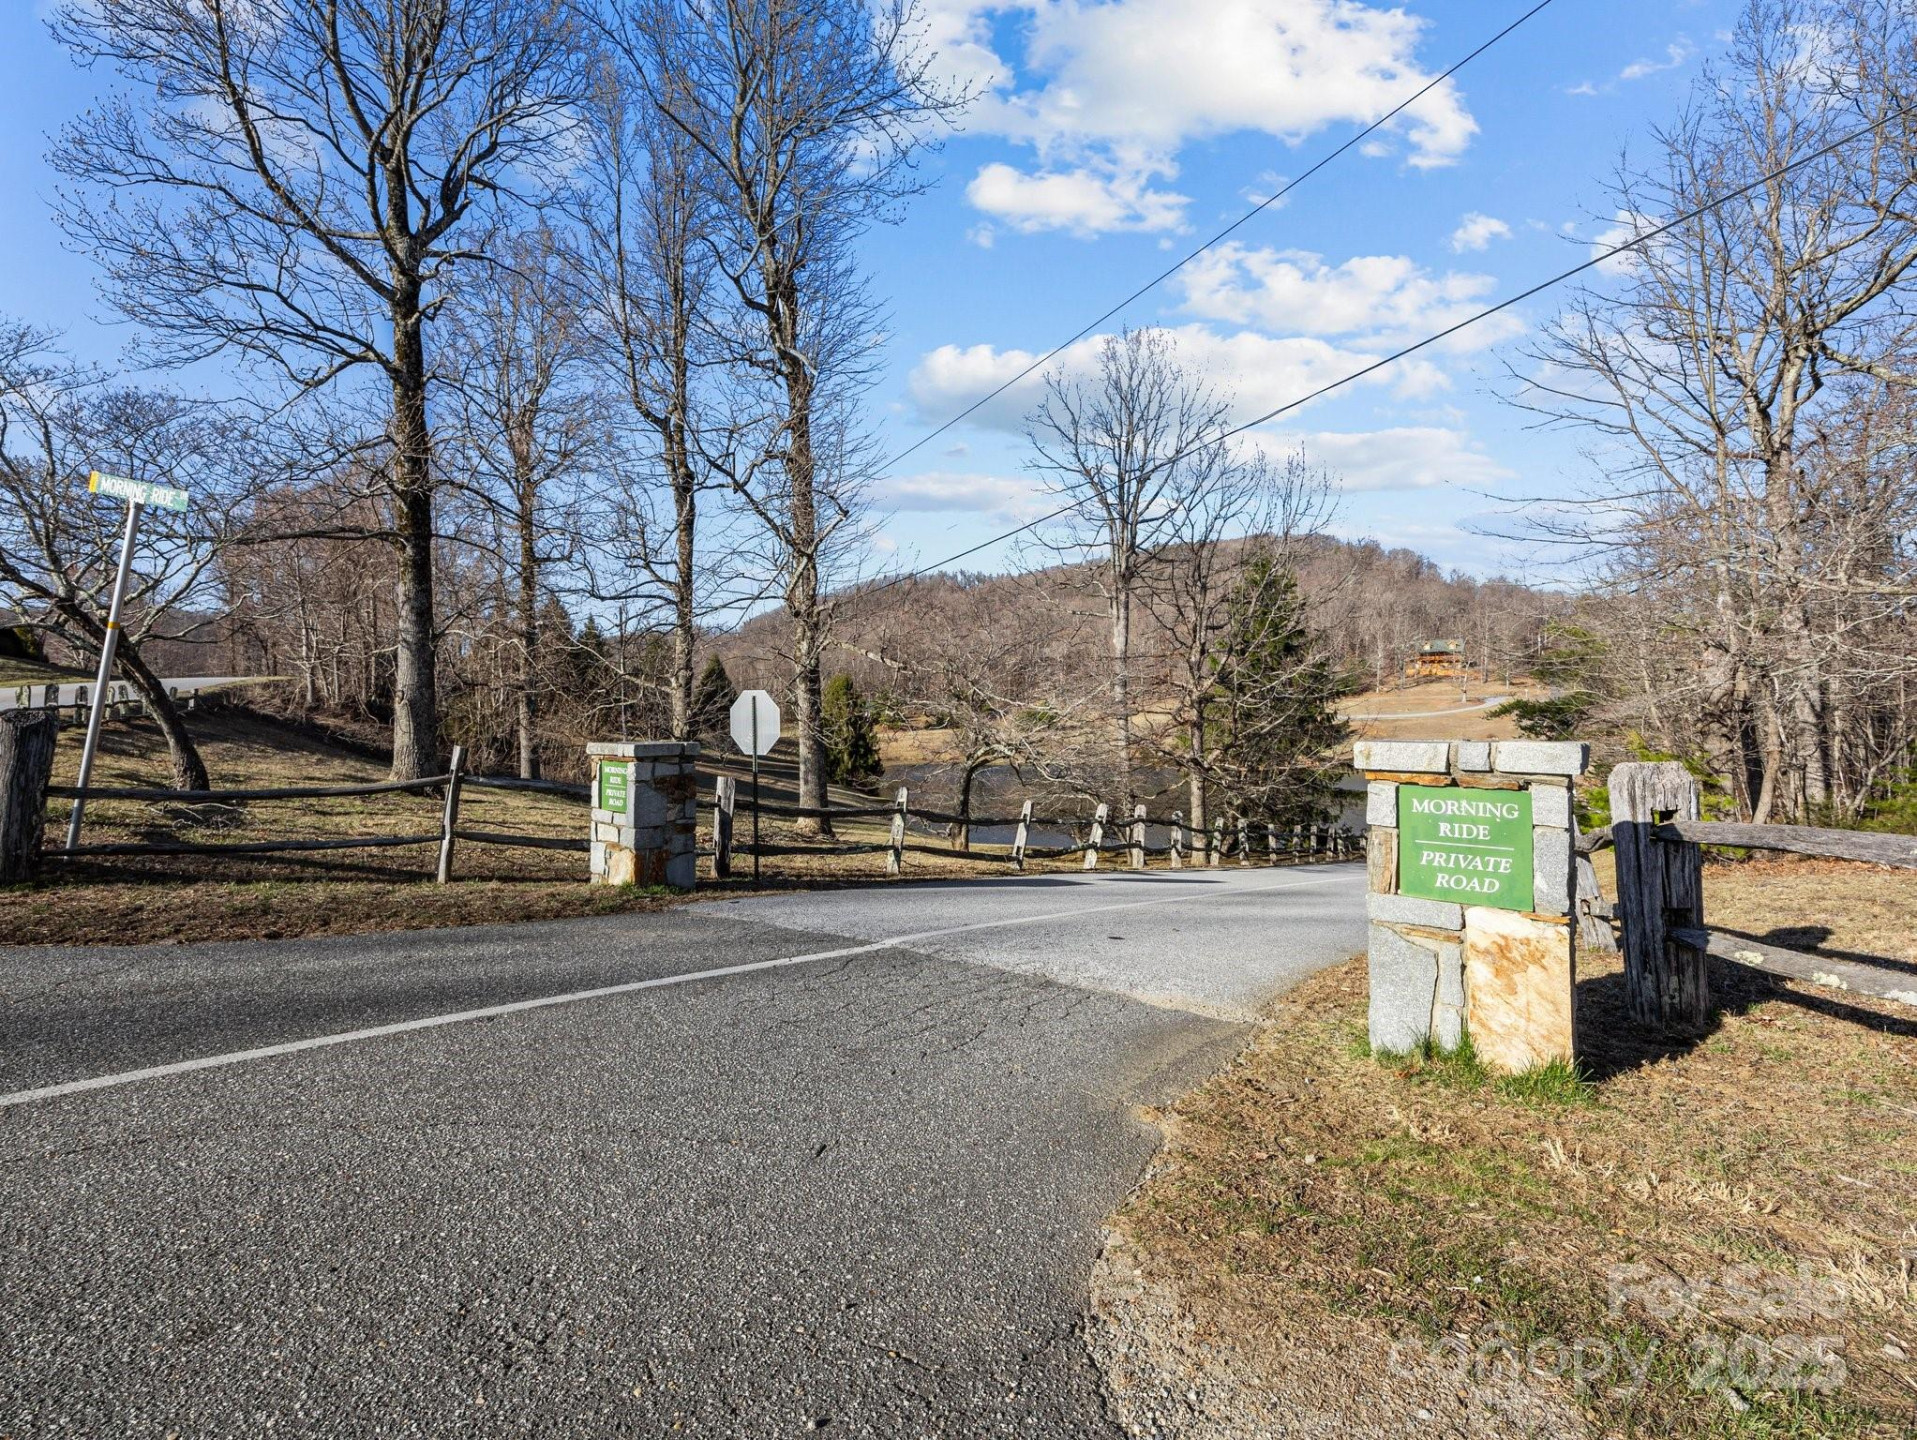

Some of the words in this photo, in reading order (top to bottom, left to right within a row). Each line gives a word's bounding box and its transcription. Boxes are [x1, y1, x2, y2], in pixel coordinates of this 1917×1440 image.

[101, 476, 147, 501] MORNING
[151, 488, 176, 507] RIDE
[604, 766, 628, 774] MORNING
[610, 776, 622, 785] RIDE
[605, 788, 627, 799] PRIVATE
[608, 798, 624, 807] ROAD
[1411, 798, 1520, 821] MORNING
[1438, 822, 1491, 840] RIDE
[1420, 850, 1513, 874] PRIVATE
[1434, 872, 1500, 893] ROAD
